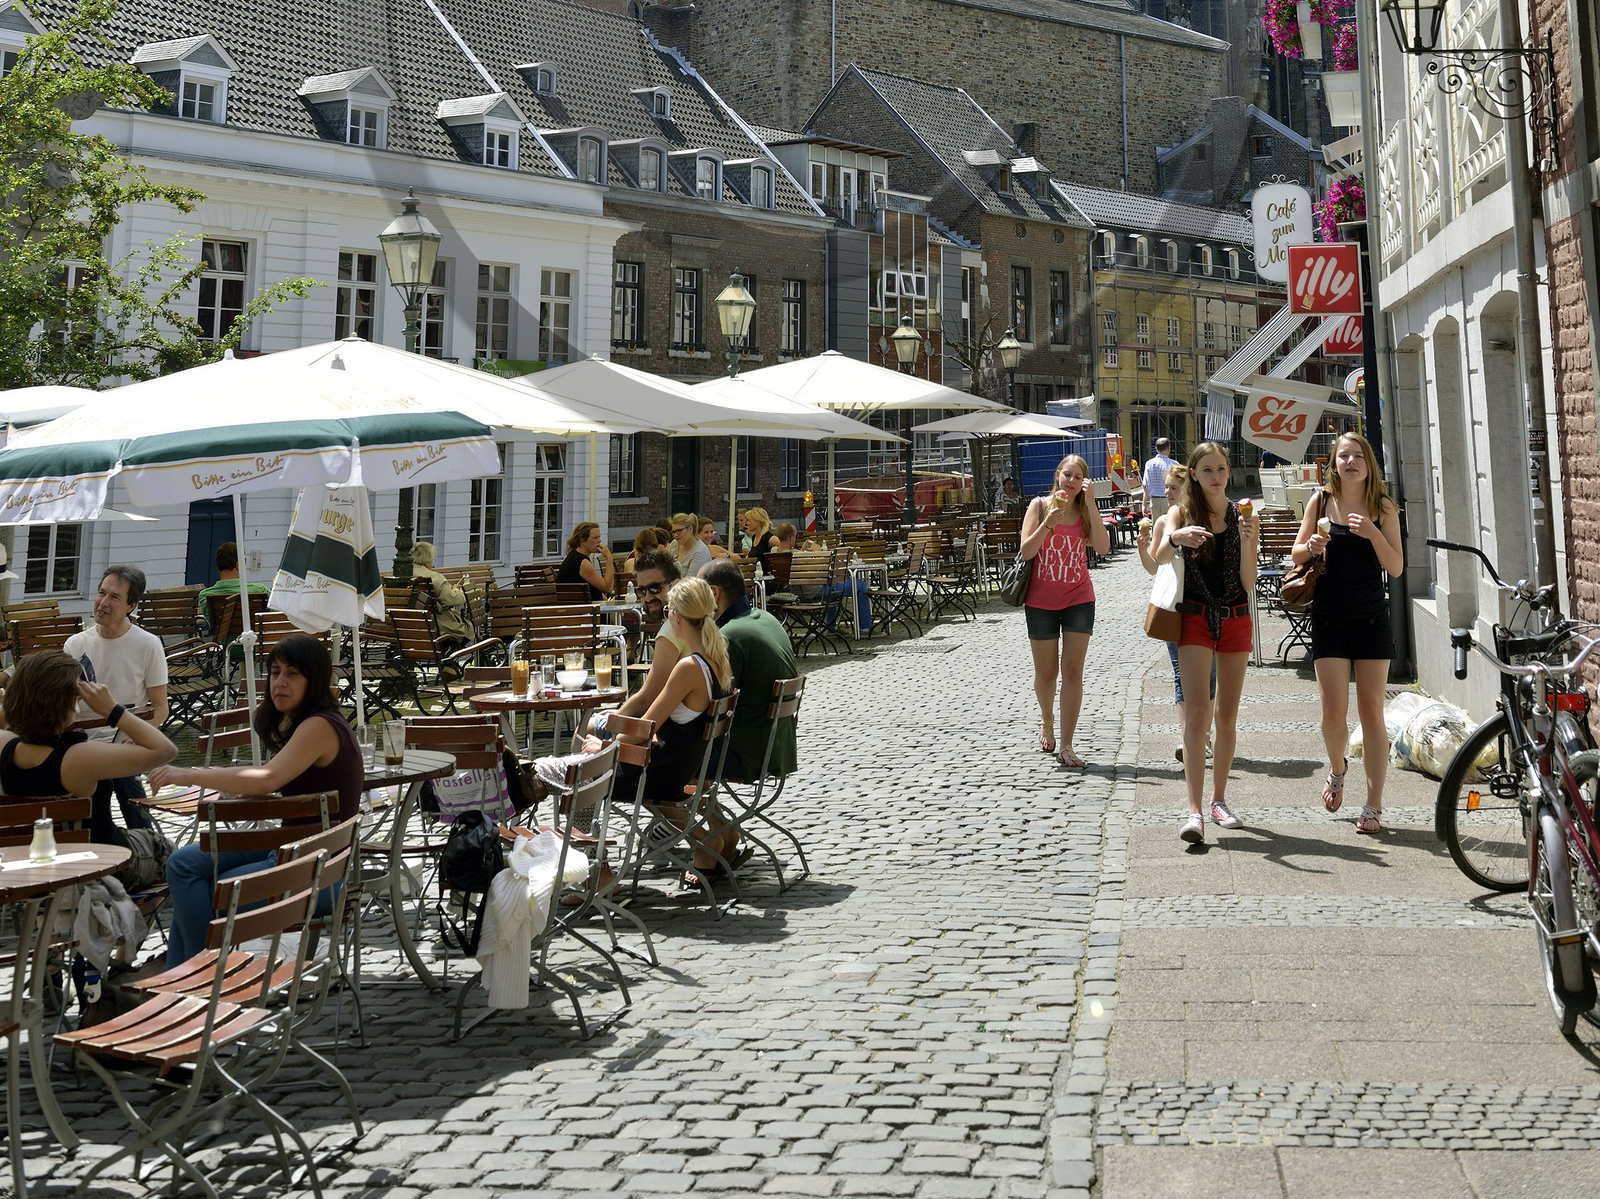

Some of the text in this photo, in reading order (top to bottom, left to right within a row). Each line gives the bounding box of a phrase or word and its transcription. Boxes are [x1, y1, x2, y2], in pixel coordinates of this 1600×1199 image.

[1266, 198, 1296, 222] Café
[1272, 223, 1295, 244] zum
[1295, 256, 1355, 305] illy
[1249, 396, 1307, 434] Eis
[192, 455, 283, 490] Bitte ein Bit
[392, 444, 445, 475] Bitte ein Bit
[6, 494, 33, 509] Bitte
[58, 479, 77, 495] Bit
